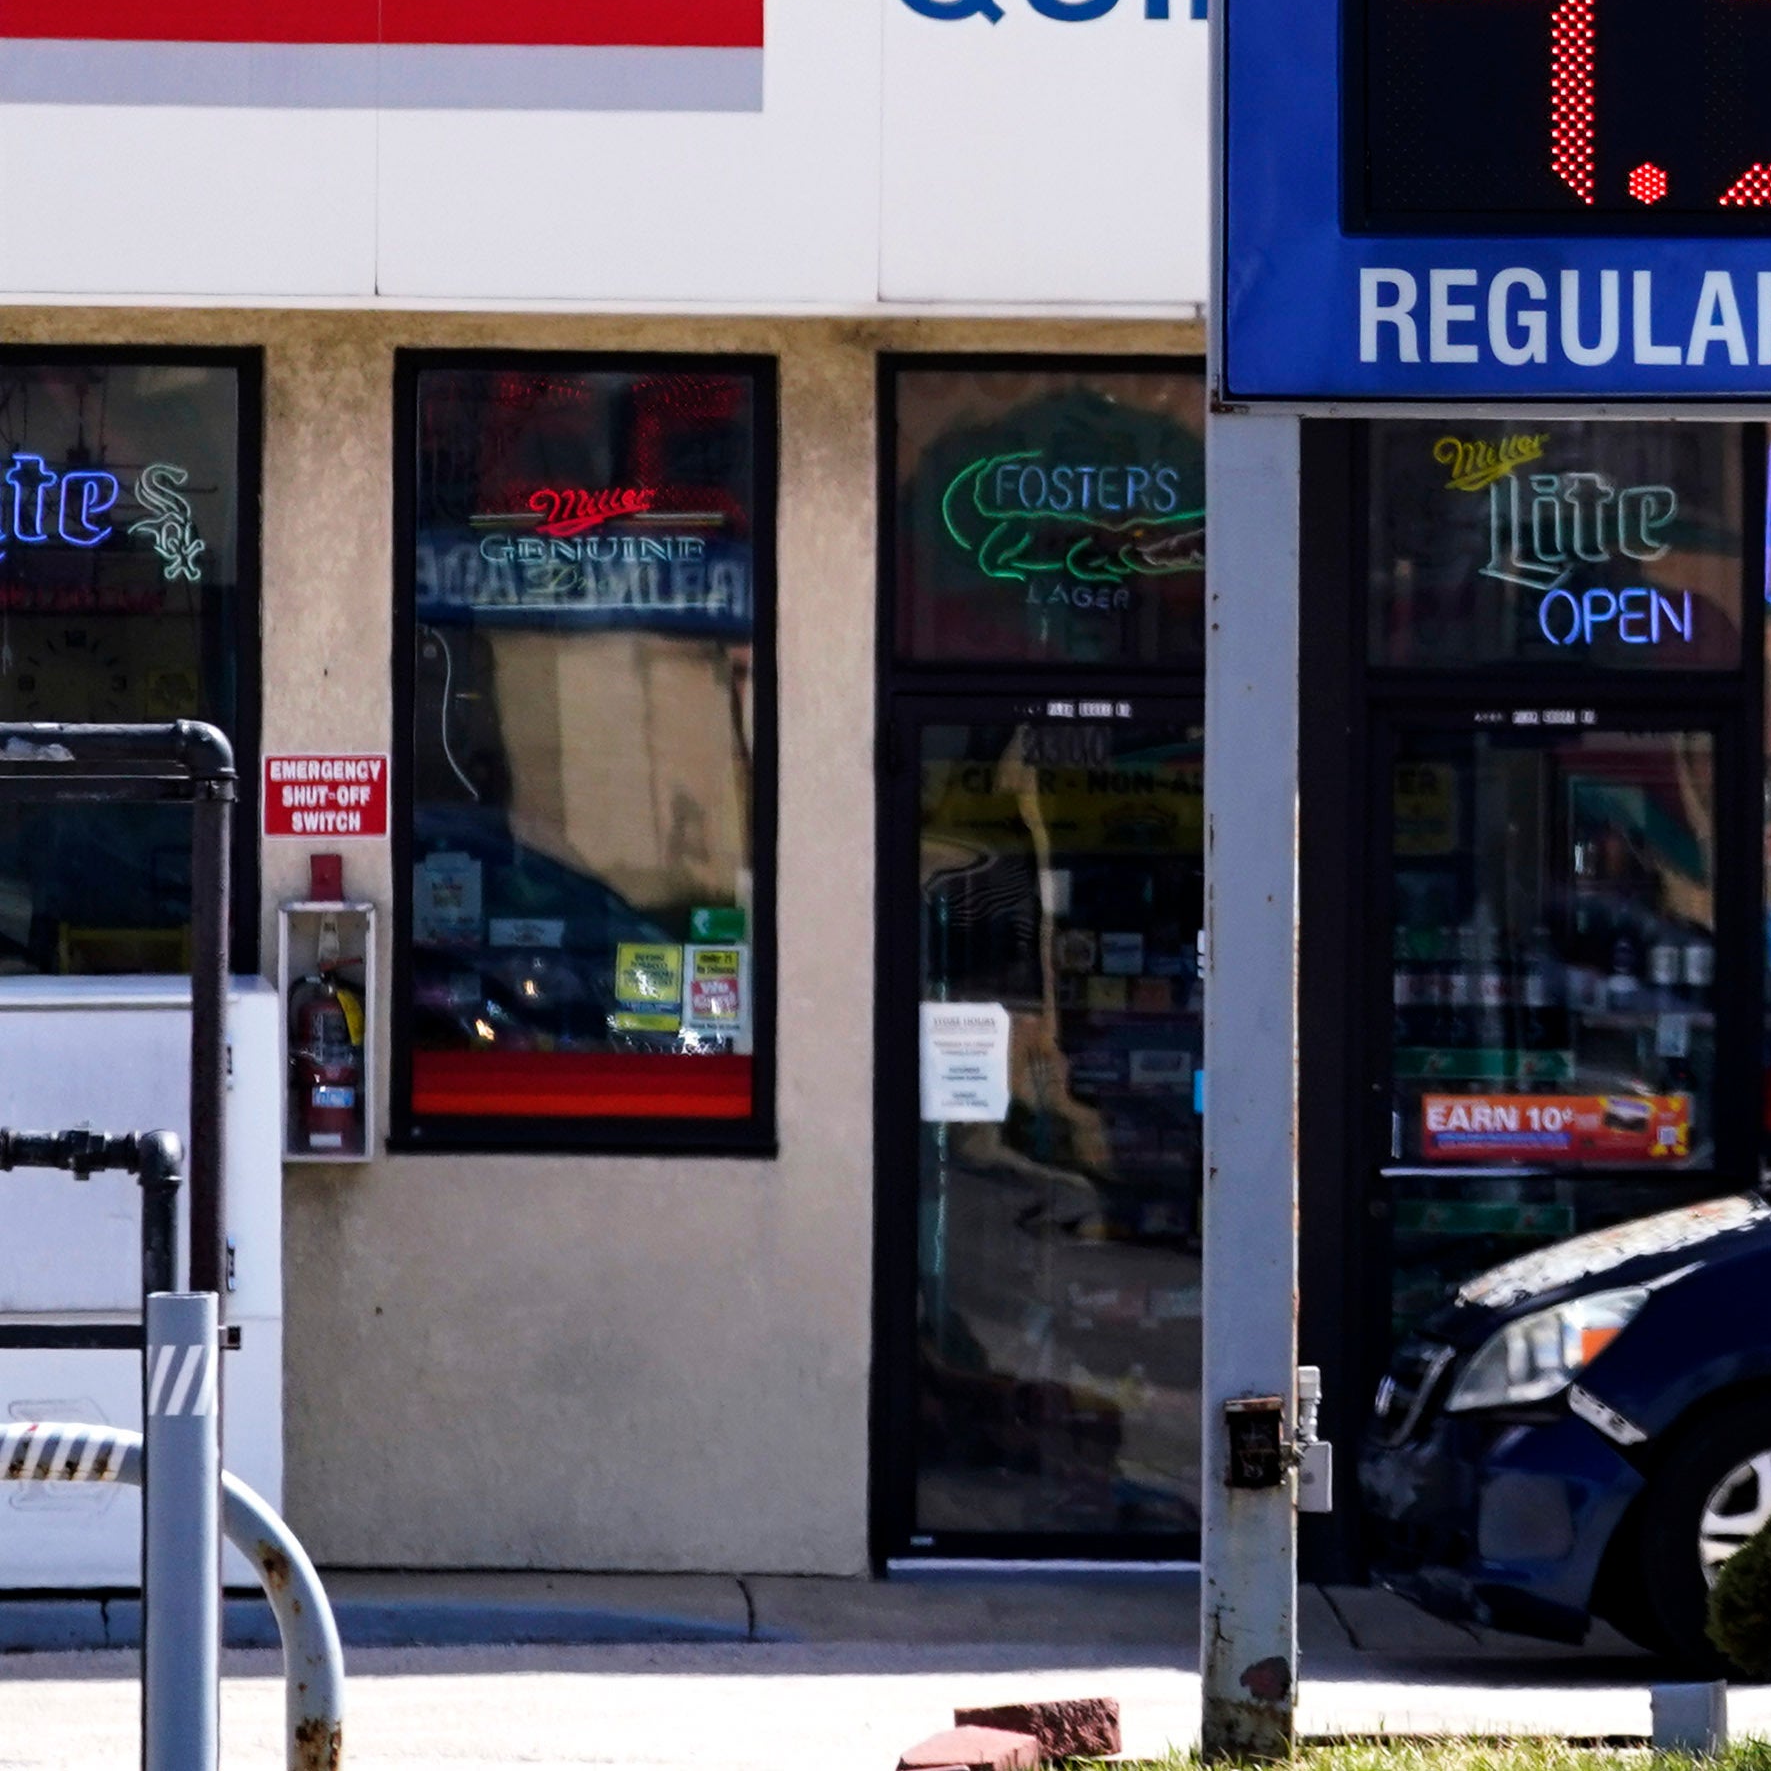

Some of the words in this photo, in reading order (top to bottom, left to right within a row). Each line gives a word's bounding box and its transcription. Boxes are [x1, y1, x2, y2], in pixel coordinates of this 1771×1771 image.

[1433, 432, 1551, 486] Miller
[0, 451, 119, 547] te
[530, 486, 656, 525] Miller
[1478, 472, 1679, 590] Lite
[479, 534, 706, 562] GENUINE
[1025, 582, 1131, 609] LAGER
[1538, 586, 1693, 646] OPEN
[269, 760, 382, 782] EMERGENCY
[281, 785, 371, 808] SHUT-OFF
[291, 811, 362, 833] SWITCH
[1425, 1105, 1520, 1132] EARN
